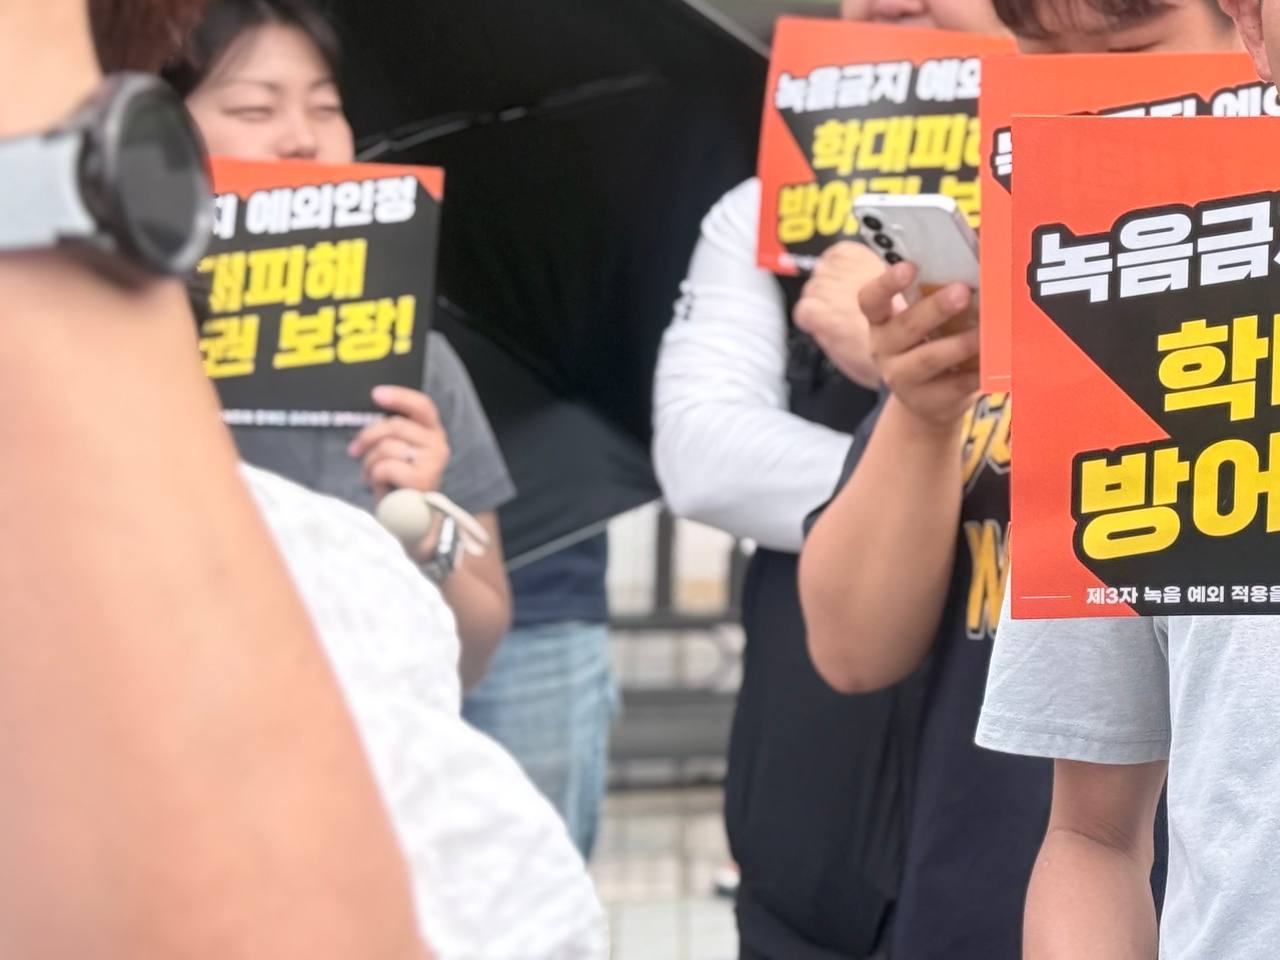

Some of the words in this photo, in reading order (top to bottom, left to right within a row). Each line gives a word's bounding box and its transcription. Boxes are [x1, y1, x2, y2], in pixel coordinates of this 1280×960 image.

[775, 59, 913, 113] 녹음금지
[246, 175, 418, 235] 예외인정
[272, 295, 417, 370] 보장!
[1086, 586, 1139, 605] 제3자
[1144, 586, 1181, 605] 녹음
[1187, 585, 1225, 603] 예외
